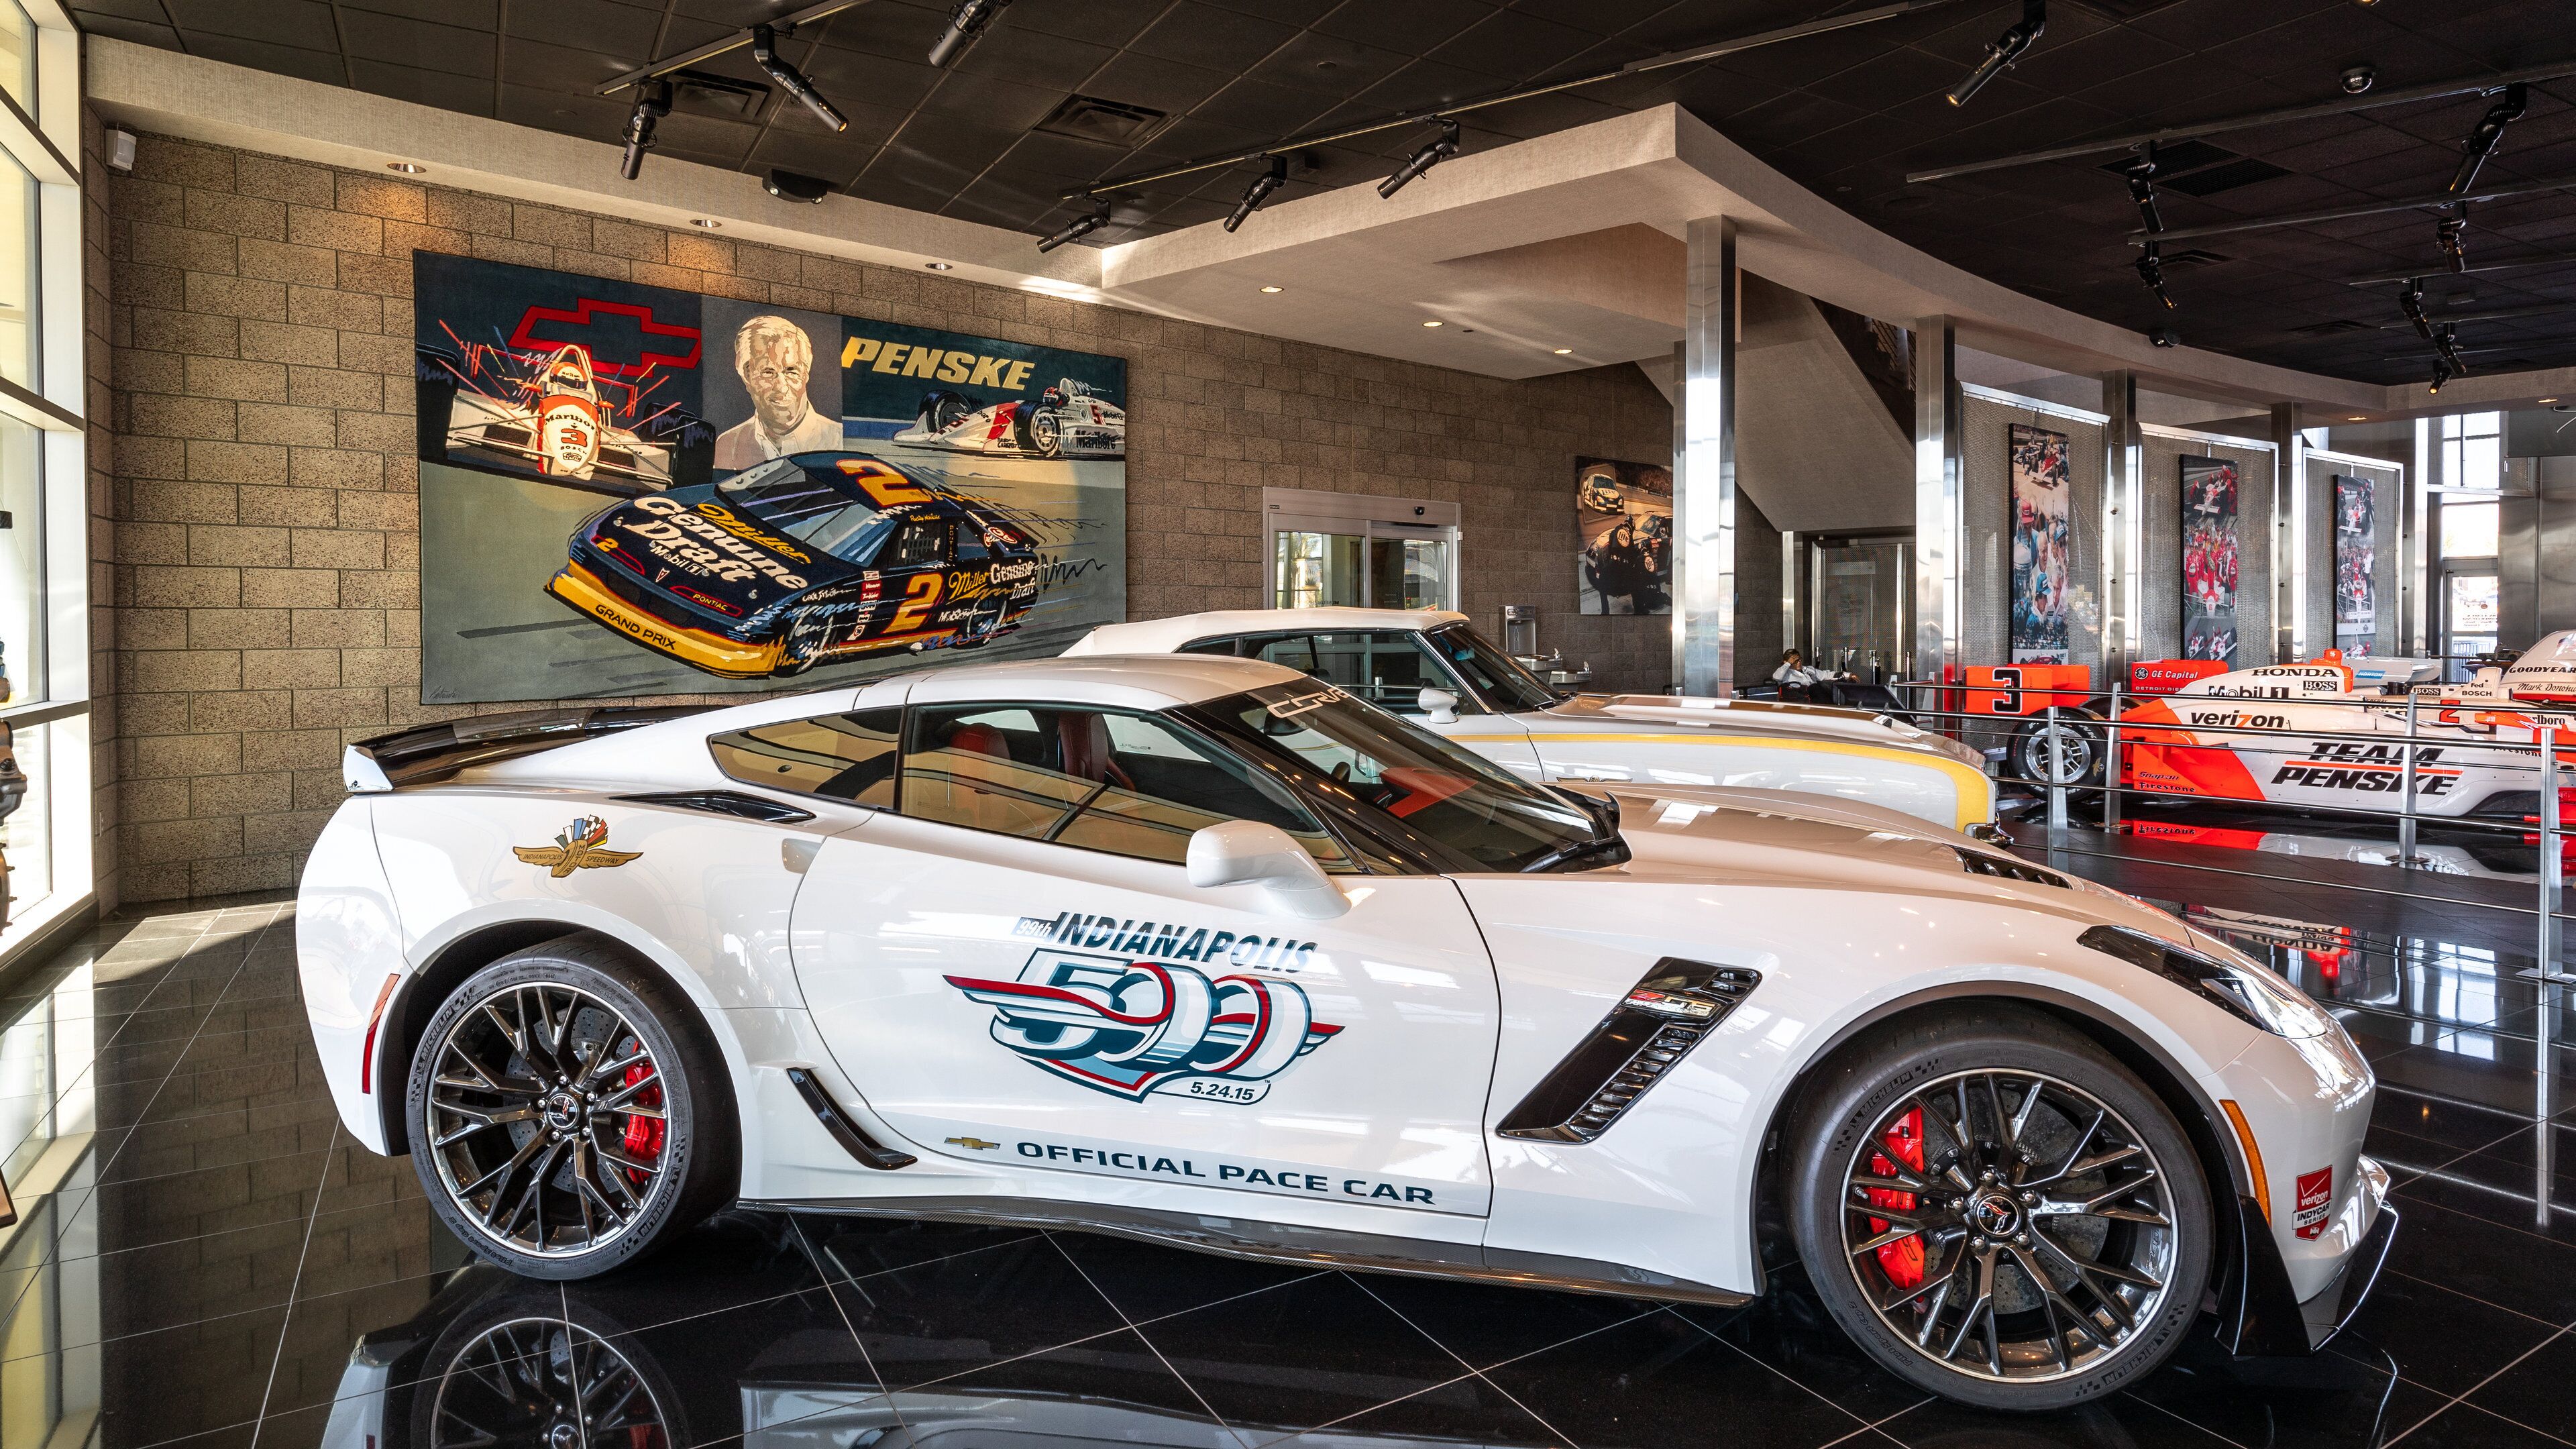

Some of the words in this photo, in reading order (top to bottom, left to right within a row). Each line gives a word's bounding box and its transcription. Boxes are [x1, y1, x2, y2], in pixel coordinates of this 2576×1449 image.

[841, 336, 1035, 390] PENSKE
[561, 429, 588, 447] 3
[836, 458, 932, 508] 2
[597, 538, 619, 552] 2
[634, 496, 808, 588] Genuine
[698, 503, 811, 564] Miller
[621, 519, 757, 582] Draft
[651, 545, 690, 568] Mobil
[949, 570, 990, 600] Miller
[693, 594, 728, 610] PONTIAC
[883, 573, 944, 634] 2
[595, 604, 641, 633] GRAND
[642, 628, 676, 651] PRIX
[2151, 670, 2163, 678] GE
[2165, 670, 2198, 680] Capital
[2251, 668, 2339, 677] HONDA
[2304, 680, 2337, 690] BOSS
[1992, 667, 2022, 714] 3
[2517, 682, 2542, 692] Mark
[2191, 710, 2285, 729] verizon
[2439, 699, 2461, 724] 2
[2308, 741, 2445, 767] TEAM
[2139, 771, 2179, 780] Snap-on
[2139, 782, 2196, 792] Firestone
[2271, 766, 2460, 796] PENSKE
[564, 844, 586, 873] MOTOR
[585, 855, 620, 864] SPEEDWAY
[1016, 920, 1053, 937] 99th
[1052, 911, 1318, 973] INDIANAPOLIS
[989, 947, 1313, 1078] 500
[420, 1006, 454, 1060] MICHELIN
[1190, 1081, 1255, 1101] 5.24.15
[1861, 1071, 1913, 1116] MICHELIN
[1017, 1142, 1206, 1177] OFFICIAL
[1219, 1165, 1328, 1192] PACE
[1344, 1179, 1436, 1205] CAR
[638, 1181, 676, 1237] MICHELIN
[2301, 1190, 2328, 1206] verizon
[2297, 1202, 2330, 1222] INDYCAR
[2304, 1213, 2326, 1225] SERIES
[2104, 1342, 2158, 1385] MICHELIN
